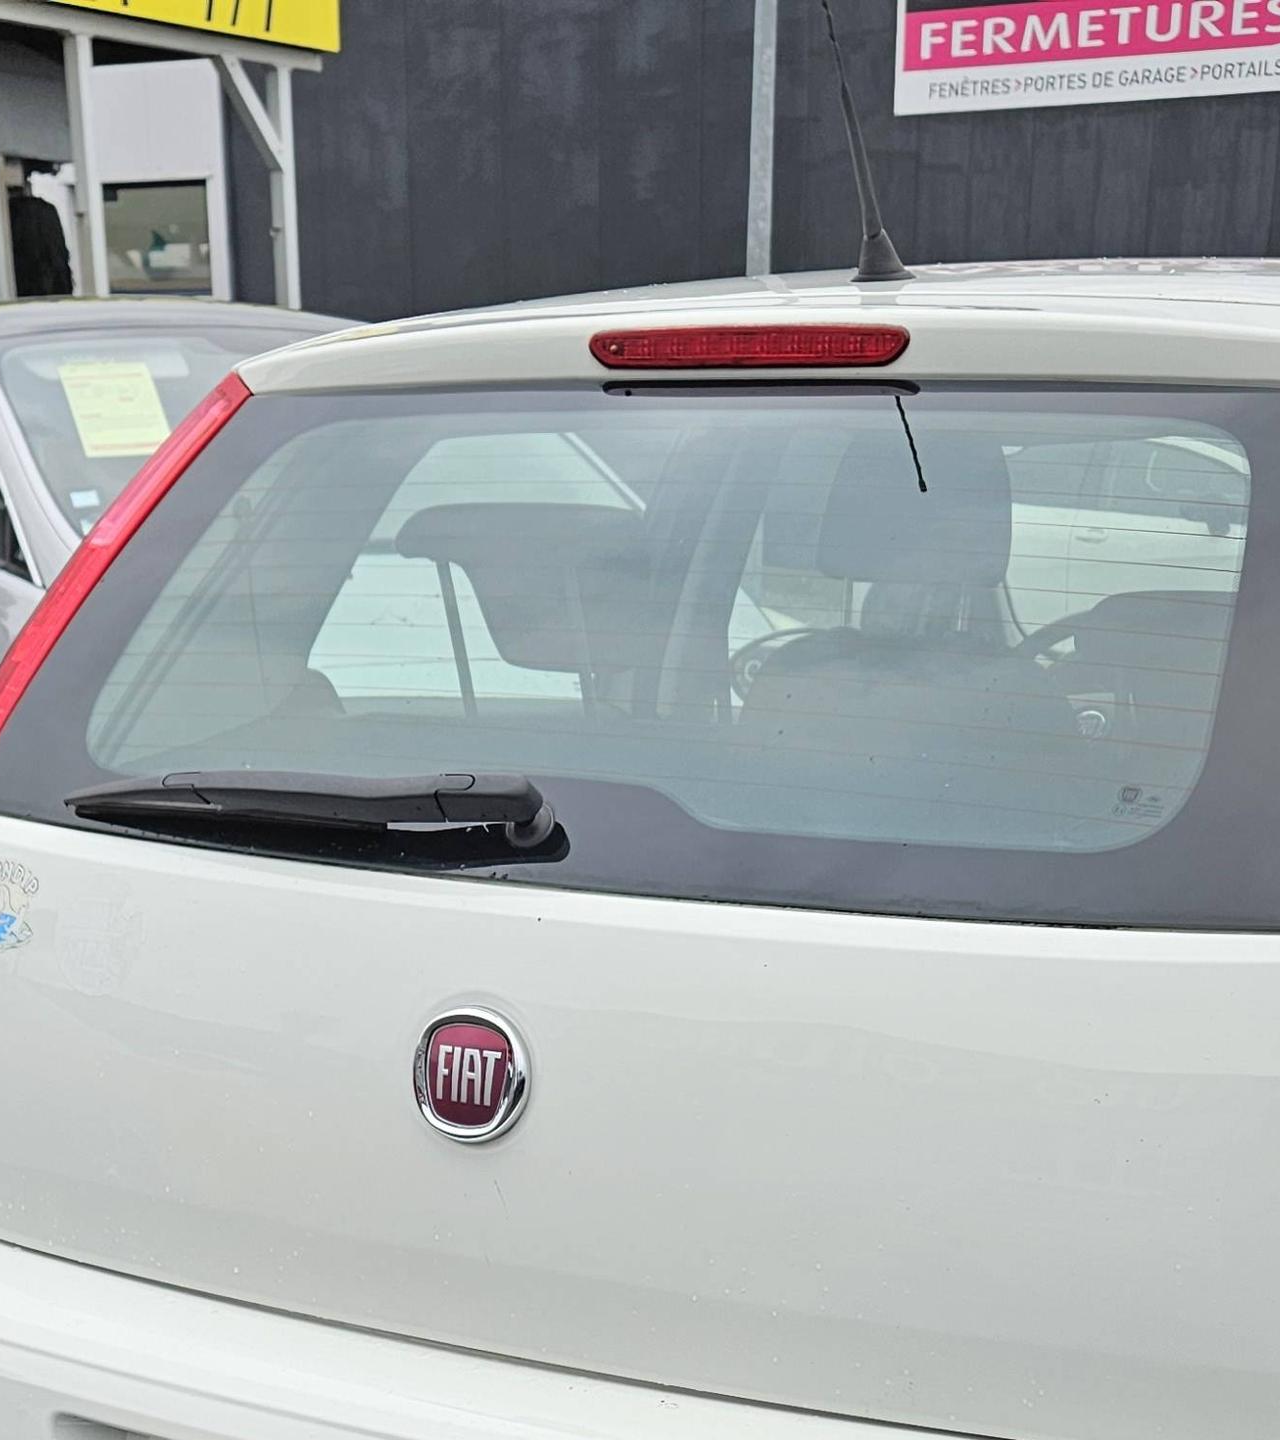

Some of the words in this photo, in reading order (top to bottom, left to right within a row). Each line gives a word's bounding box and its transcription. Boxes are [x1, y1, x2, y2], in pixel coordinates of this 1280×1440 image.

[1092, 71, 1114, 88] DE
[1119, 66, 1186, 87] GARAGE
[436, 1044, 502, 1107] FIAT
